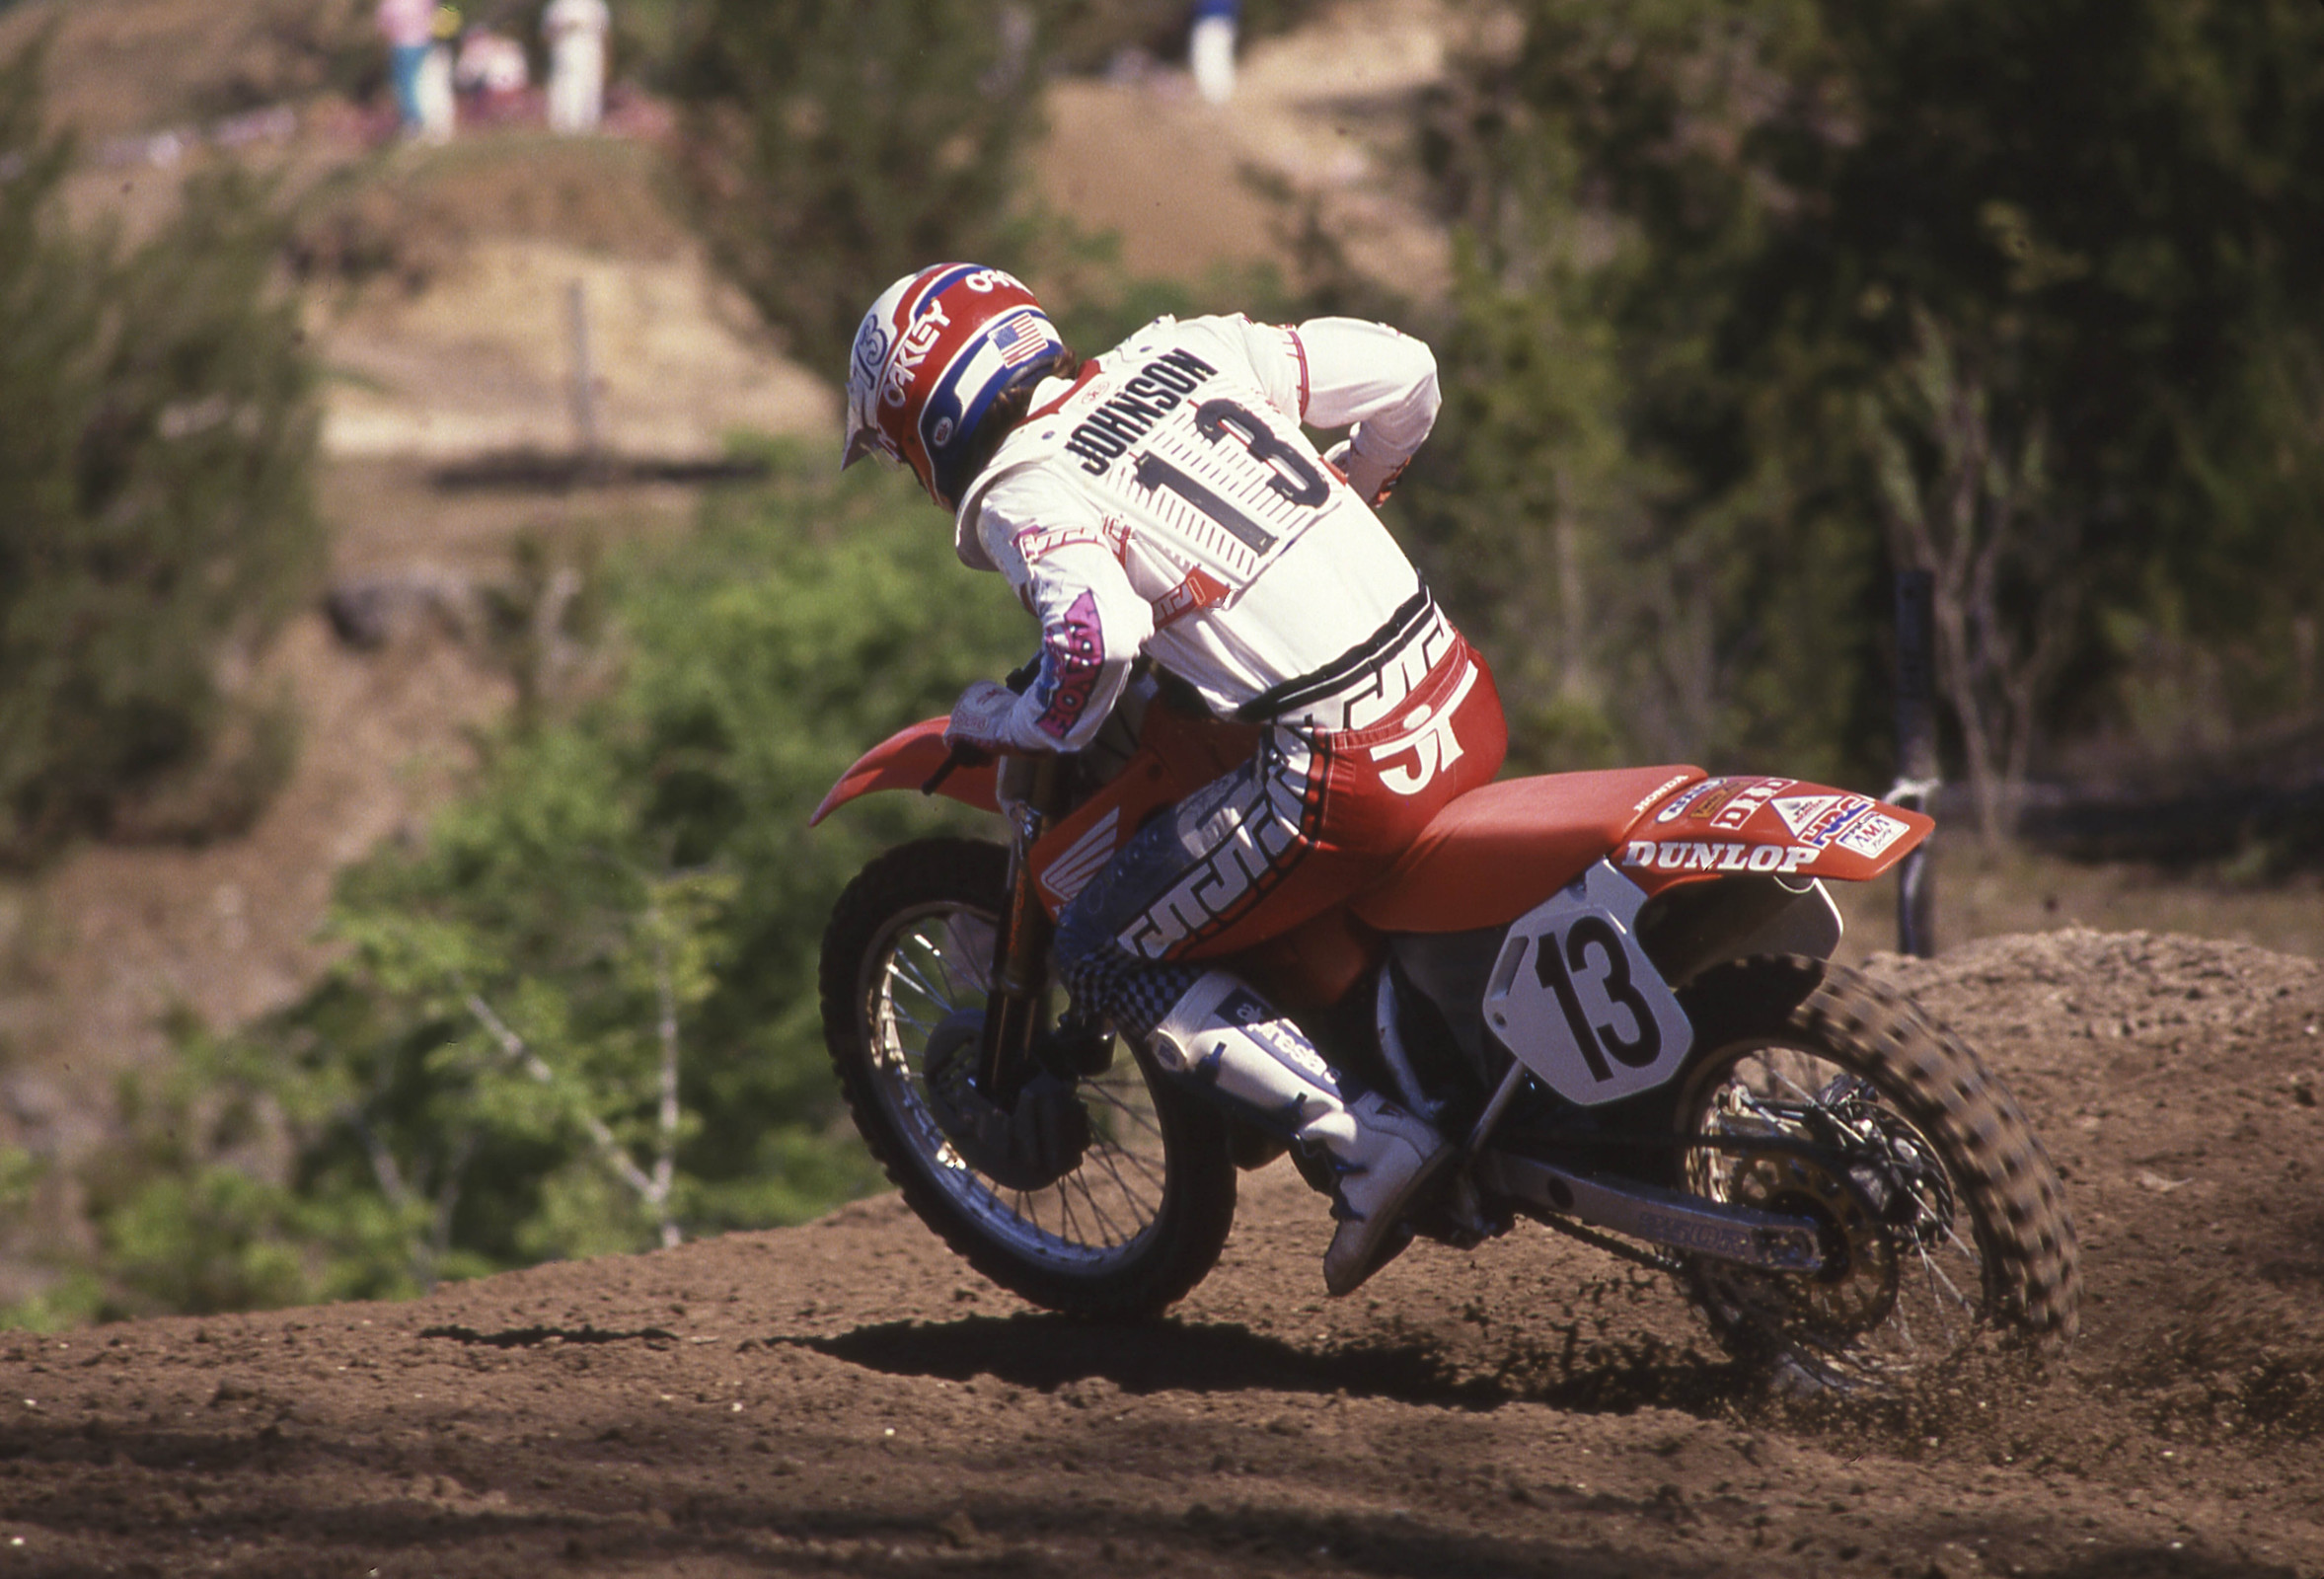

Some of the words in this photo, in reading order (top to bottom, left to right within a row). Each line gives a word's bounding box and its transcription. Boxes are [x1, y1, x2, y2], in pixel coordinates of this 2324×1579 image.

[882, 298, 950, 408] OAKLEY
[1065, 347, 1219, 476] JOHNSON
[1133, 398, 1330, 559] 13
[1370, 659, 1478, 795] JT
[1622, 841, 1821, 872] DUNLOP
[1633, 775, 1688, 812] HONDA
[1535, 916, 1662, 1083] 13
